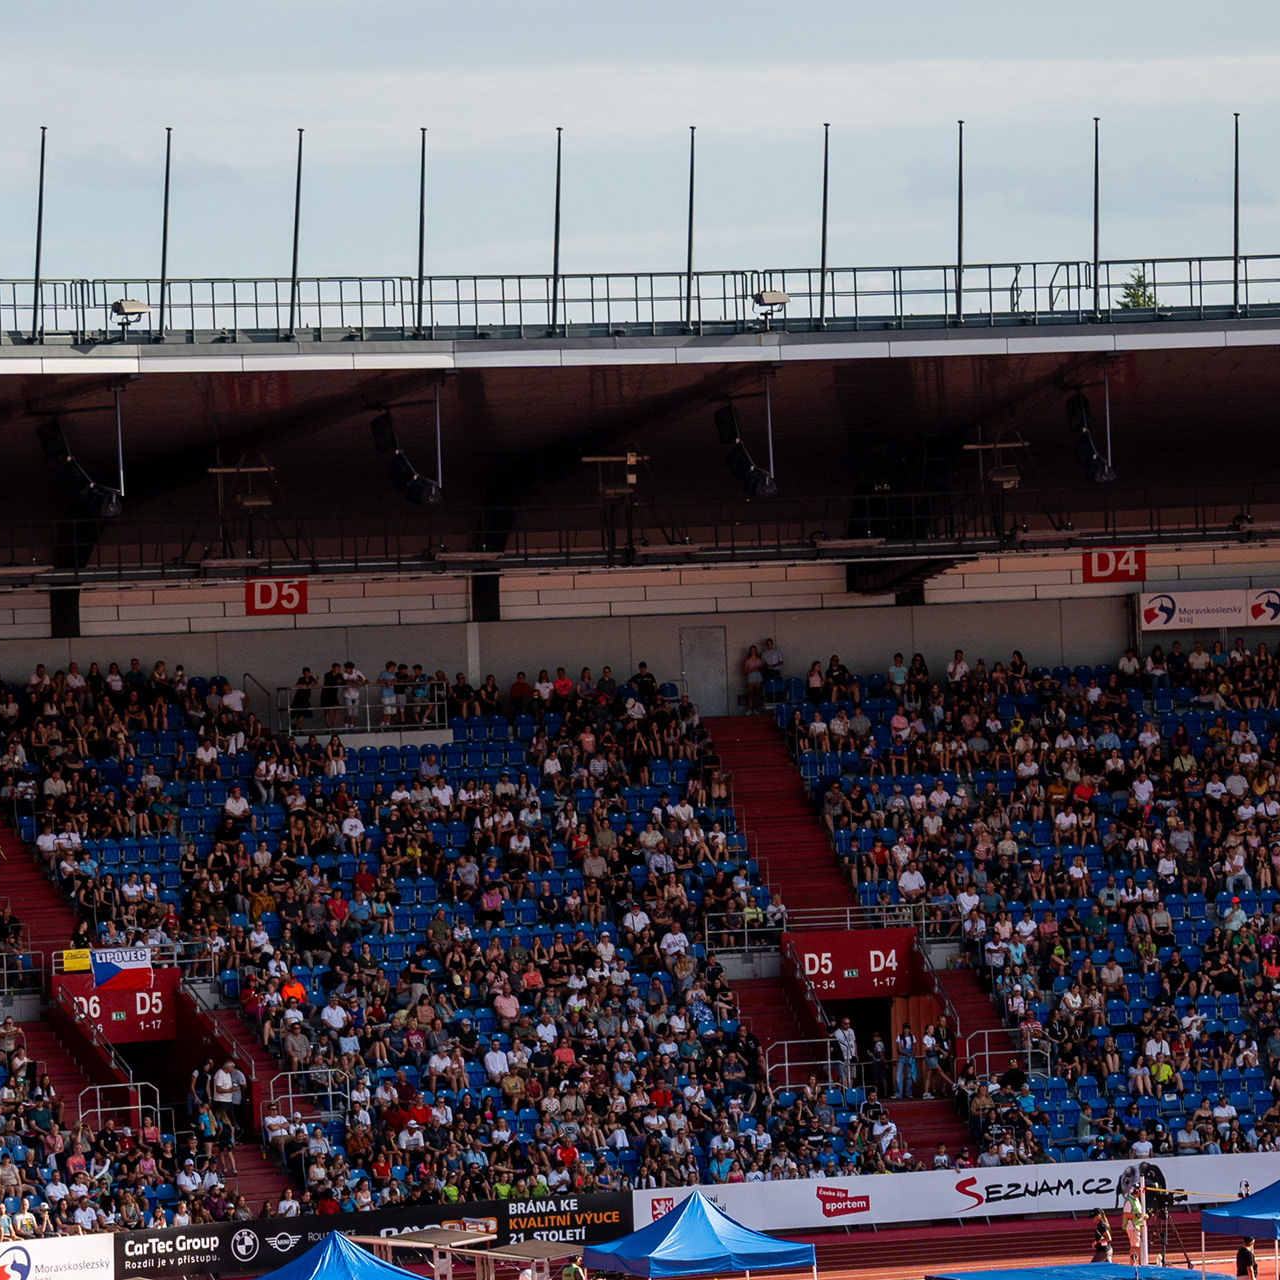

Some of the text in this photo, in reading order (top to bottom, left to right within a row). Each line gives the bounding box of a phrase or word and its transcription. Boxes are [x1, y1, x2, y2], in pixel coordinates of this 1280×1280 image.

[1091, 547, 1138, 577] D4
[254, 581, 300, 610] D5
[1178, 605, 1243, 617] Moravskoslezský
[1178, 616, 1194, 625] kraj
[95, 949, 147, 964] LIPOVEC
[804, 949, 898, 975] D5 D4
[136, 992, 163, 1015] D5
[818, 1189, 836, 1197] Česko
[509, 1198, 578, 1215] BRÁNA KE
[825, 1199, 867, 1212] sportem
[509, 1213, 570, 1230] KVALITNÍ
[575, 1210, 620, 1225] VÝUCE
[124, 1235, 220, 1257] CarTec Group
[34, 1258, 111, 1275] Moravskoslezský
[125, 1258, 155, 1270] Rozdíl
[157, 1257, 167, 1268] je
[169, 1258, 175, 1266] v
